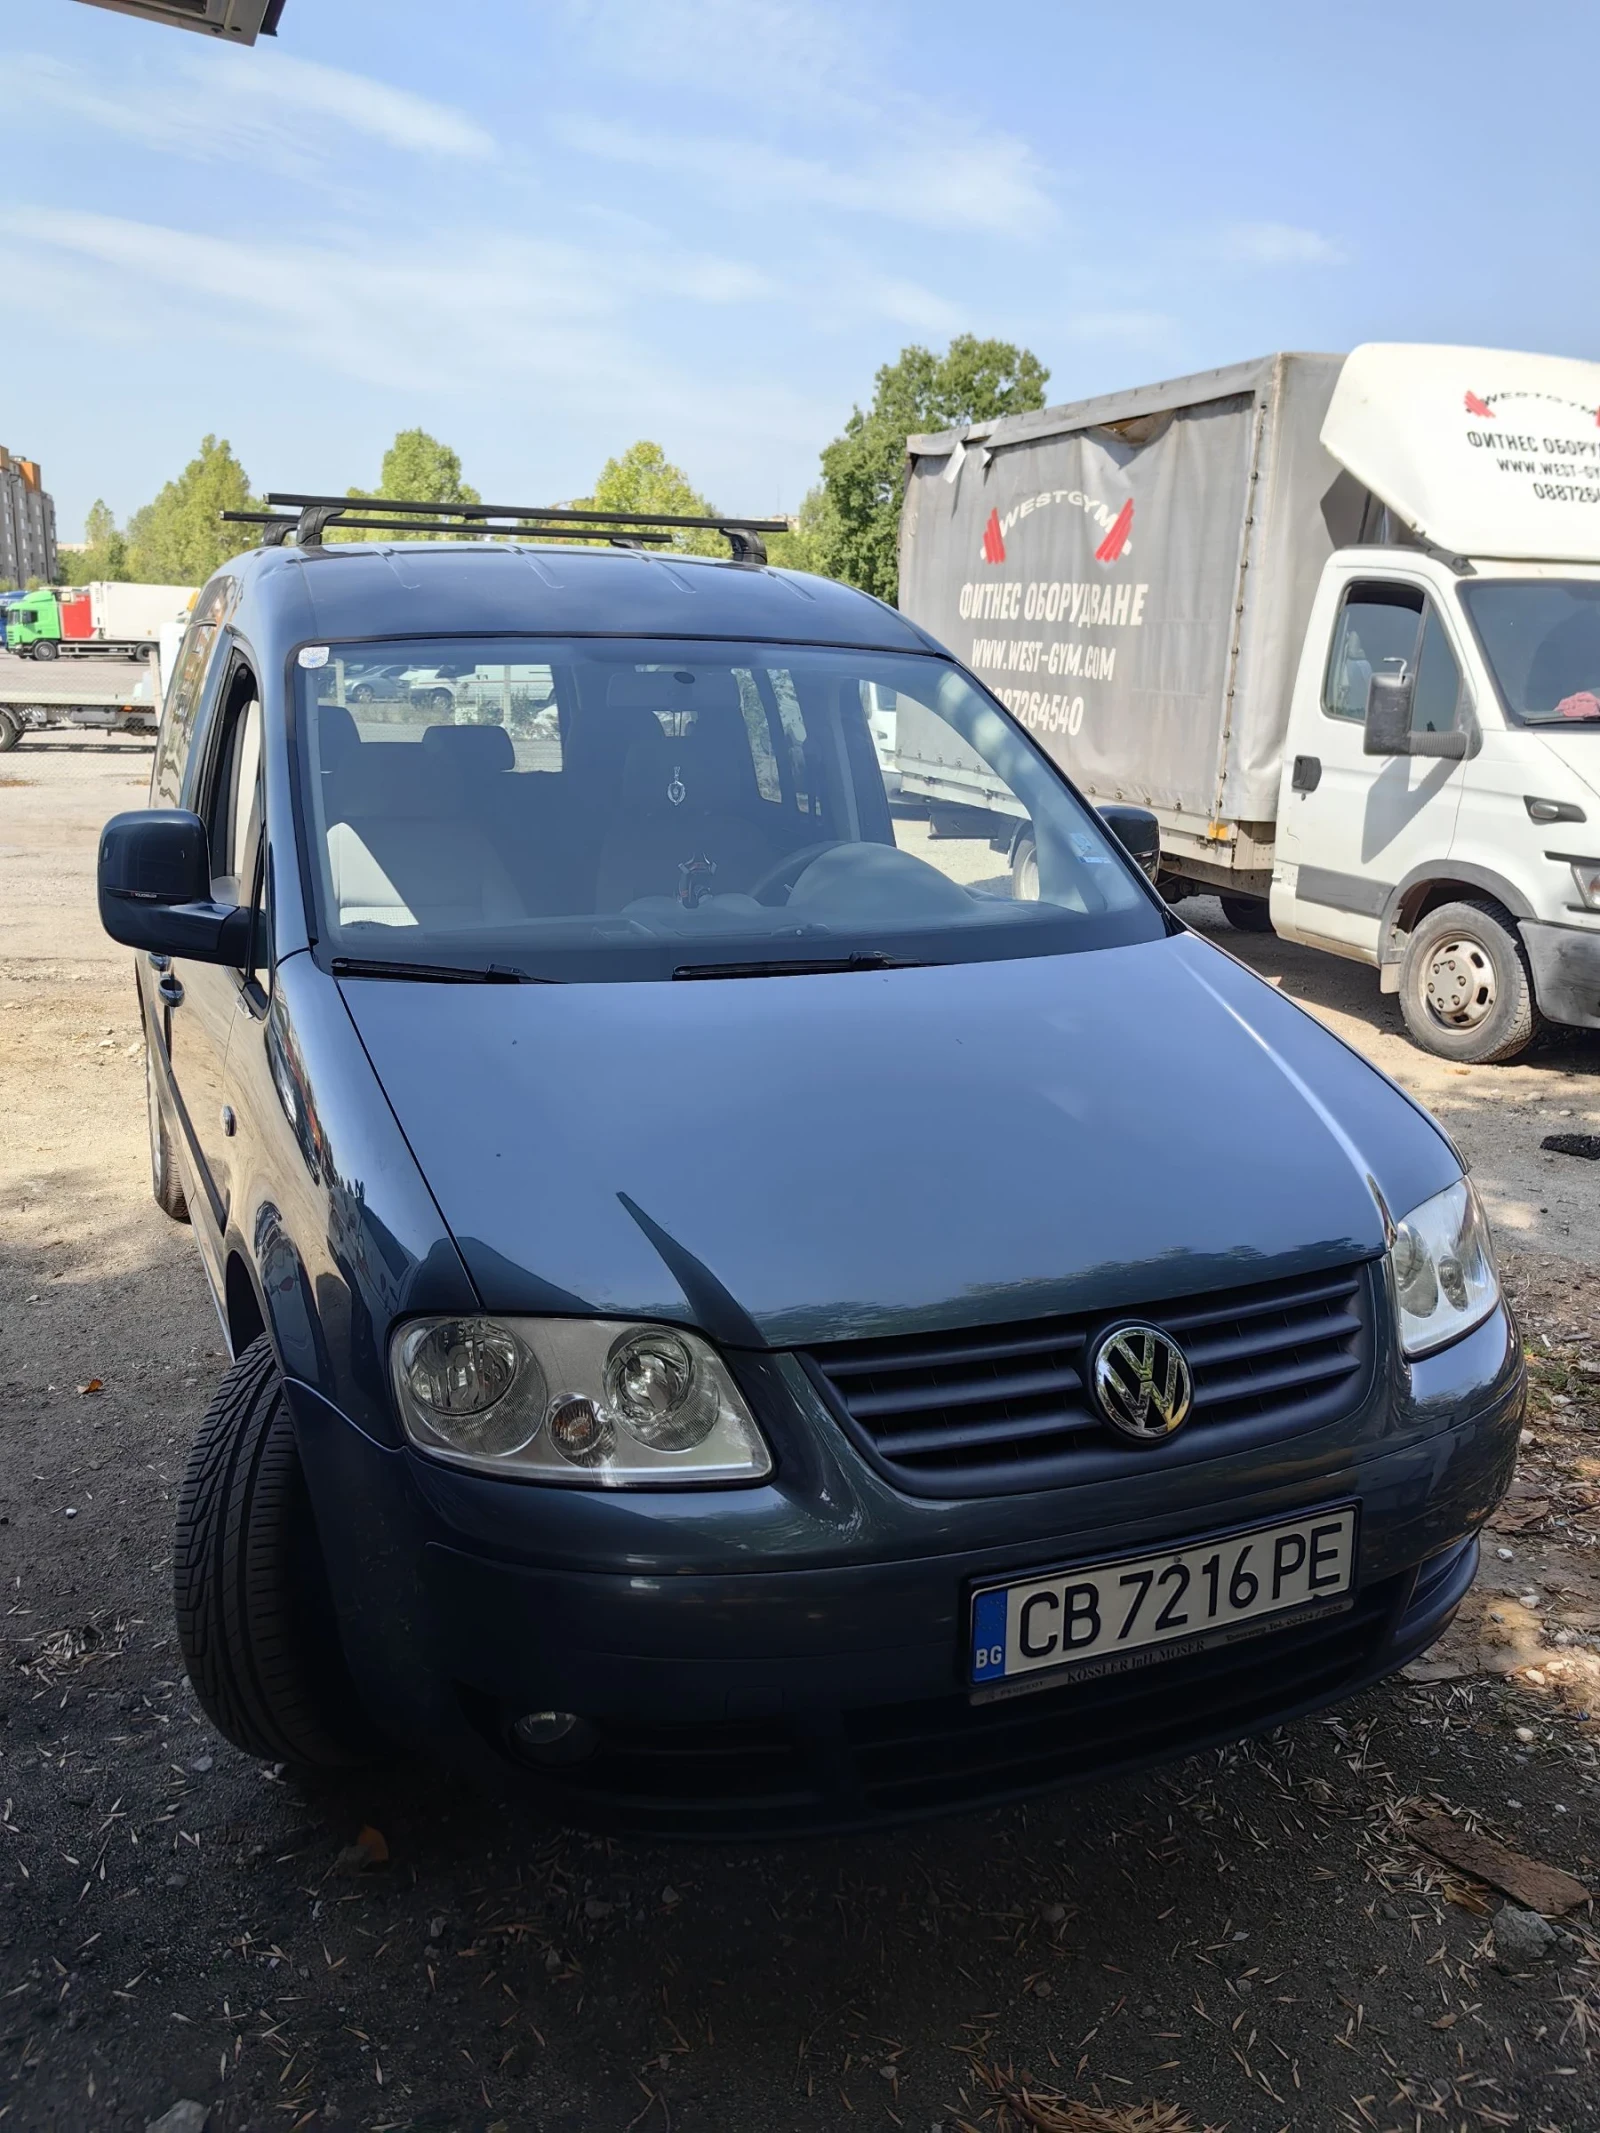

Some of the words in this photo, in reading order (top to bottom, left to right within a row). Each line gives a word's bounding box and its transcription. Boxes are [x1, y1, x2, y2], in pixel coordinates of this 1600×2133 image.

[1466, 431, 1539, 453] ФИТНЕС
[1543, 438, 1600, 458] ОБОРУ
[998, 490, 1118, 538] WESTGYM
[959, 582, 1021, 621] ФИТНЕС
[1024, 582, 1149, 628] ОБОРУДВАНЕ
[971, 638, 1116, 681] WWW.WEST-GYM.COM
[988, 686, 1084, 736] 87264540
[1019, 1582, 1100, 1658] CB
[1117, 1545, 1259, 1640] 7216
[1271, 1522, 1343, 1601] PE
[975, 1644, 1003, 1669] BG
